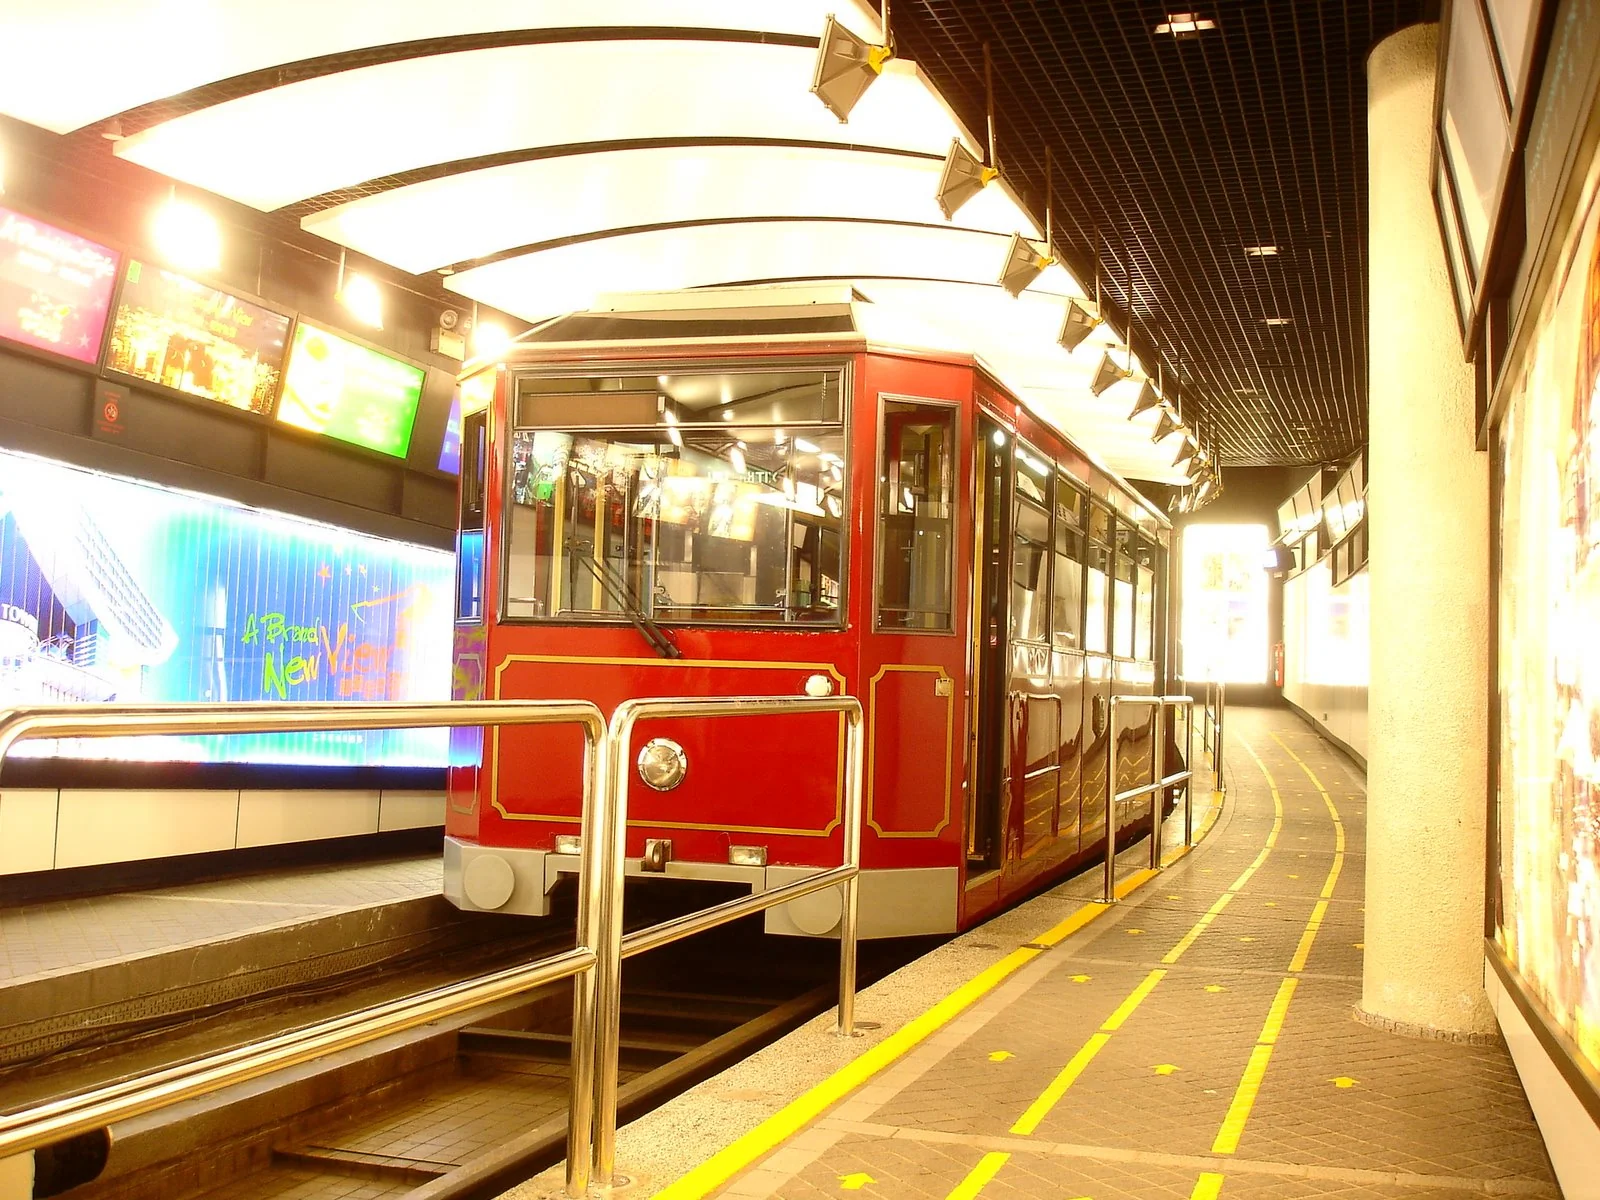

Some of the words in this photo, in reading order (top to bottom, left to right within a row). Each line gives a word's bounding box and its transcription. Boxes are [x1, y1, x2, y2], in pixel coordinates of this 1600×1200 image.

[241, 613, 259, 645] A
[260, 612, 320, 646] Brand
[263, 643, 321, 700] New
